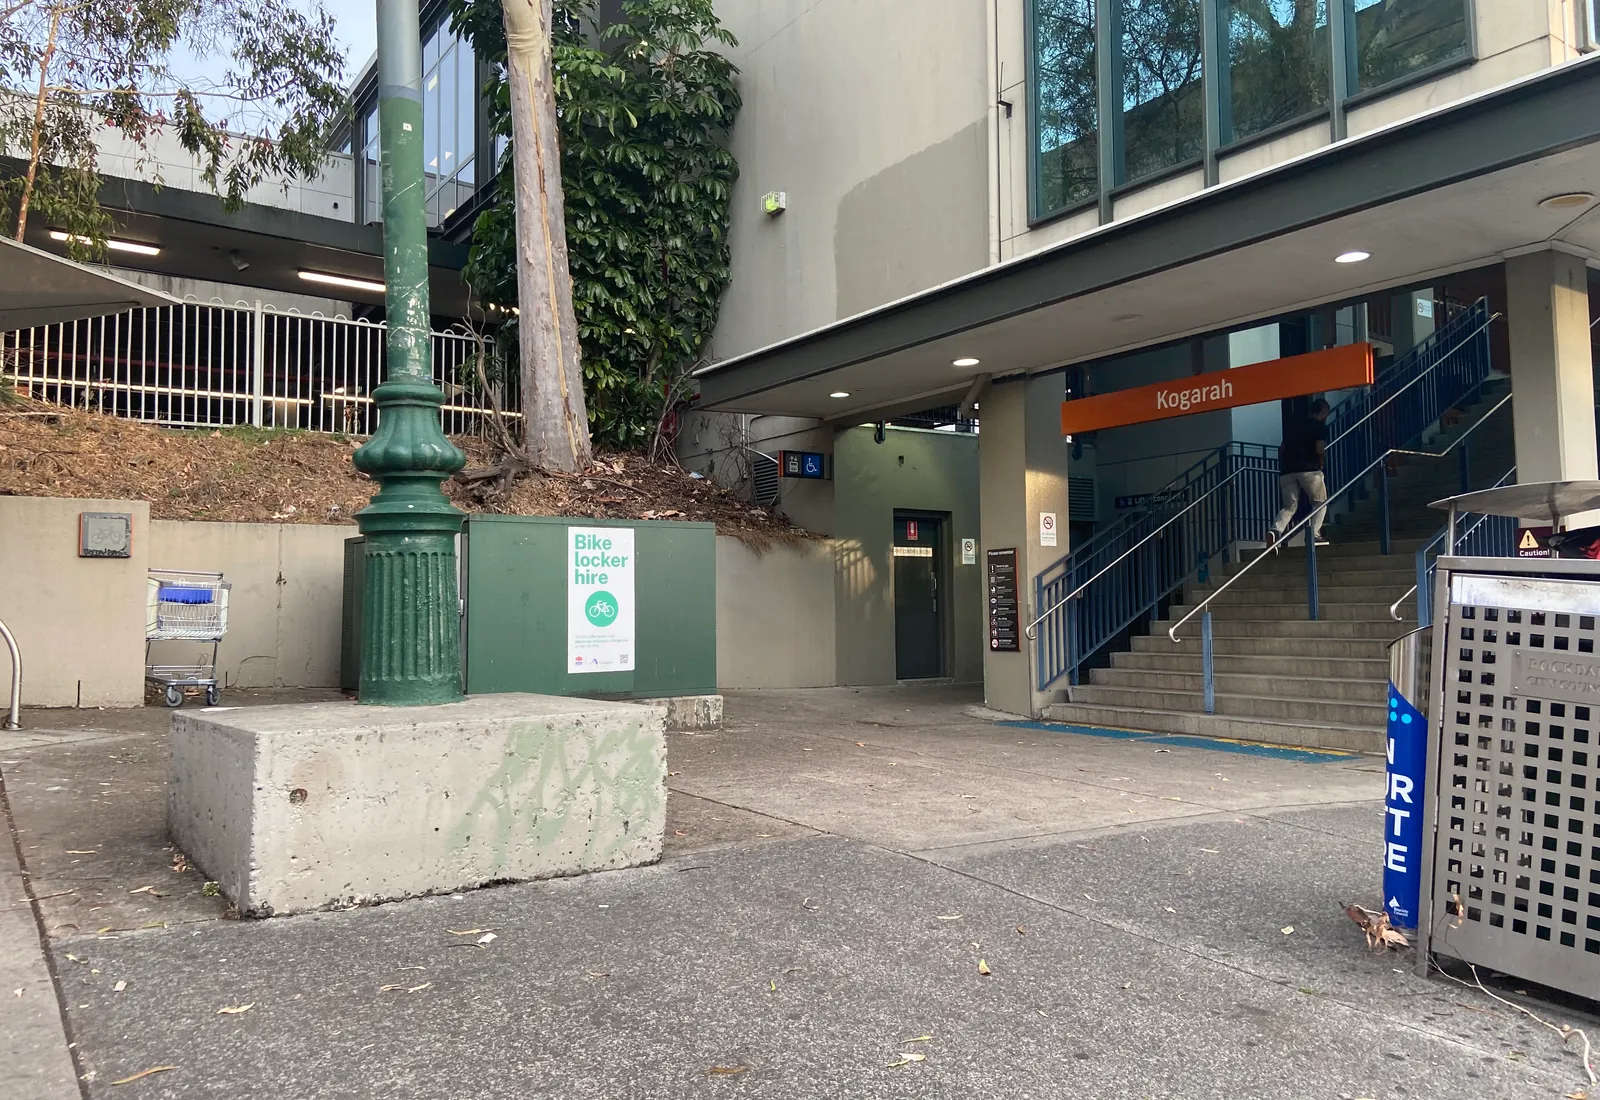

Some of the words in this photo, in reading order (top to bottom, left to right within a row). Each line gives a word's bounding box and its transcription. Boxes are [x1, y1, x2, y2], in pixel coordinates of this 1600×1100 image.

[1157, 378, 1233, 410] Kogarah
[574, 534, 612, 549] Bike
[574, 551, 628, 567] locker
[1519, 549, 1550, 557] Caution!
[574, 568, 608, 584] hire
[1527, 675, 1557, 688] CITY
[1385, 805, 1411, 837] T
[1383, 840, 1408, 873] E
